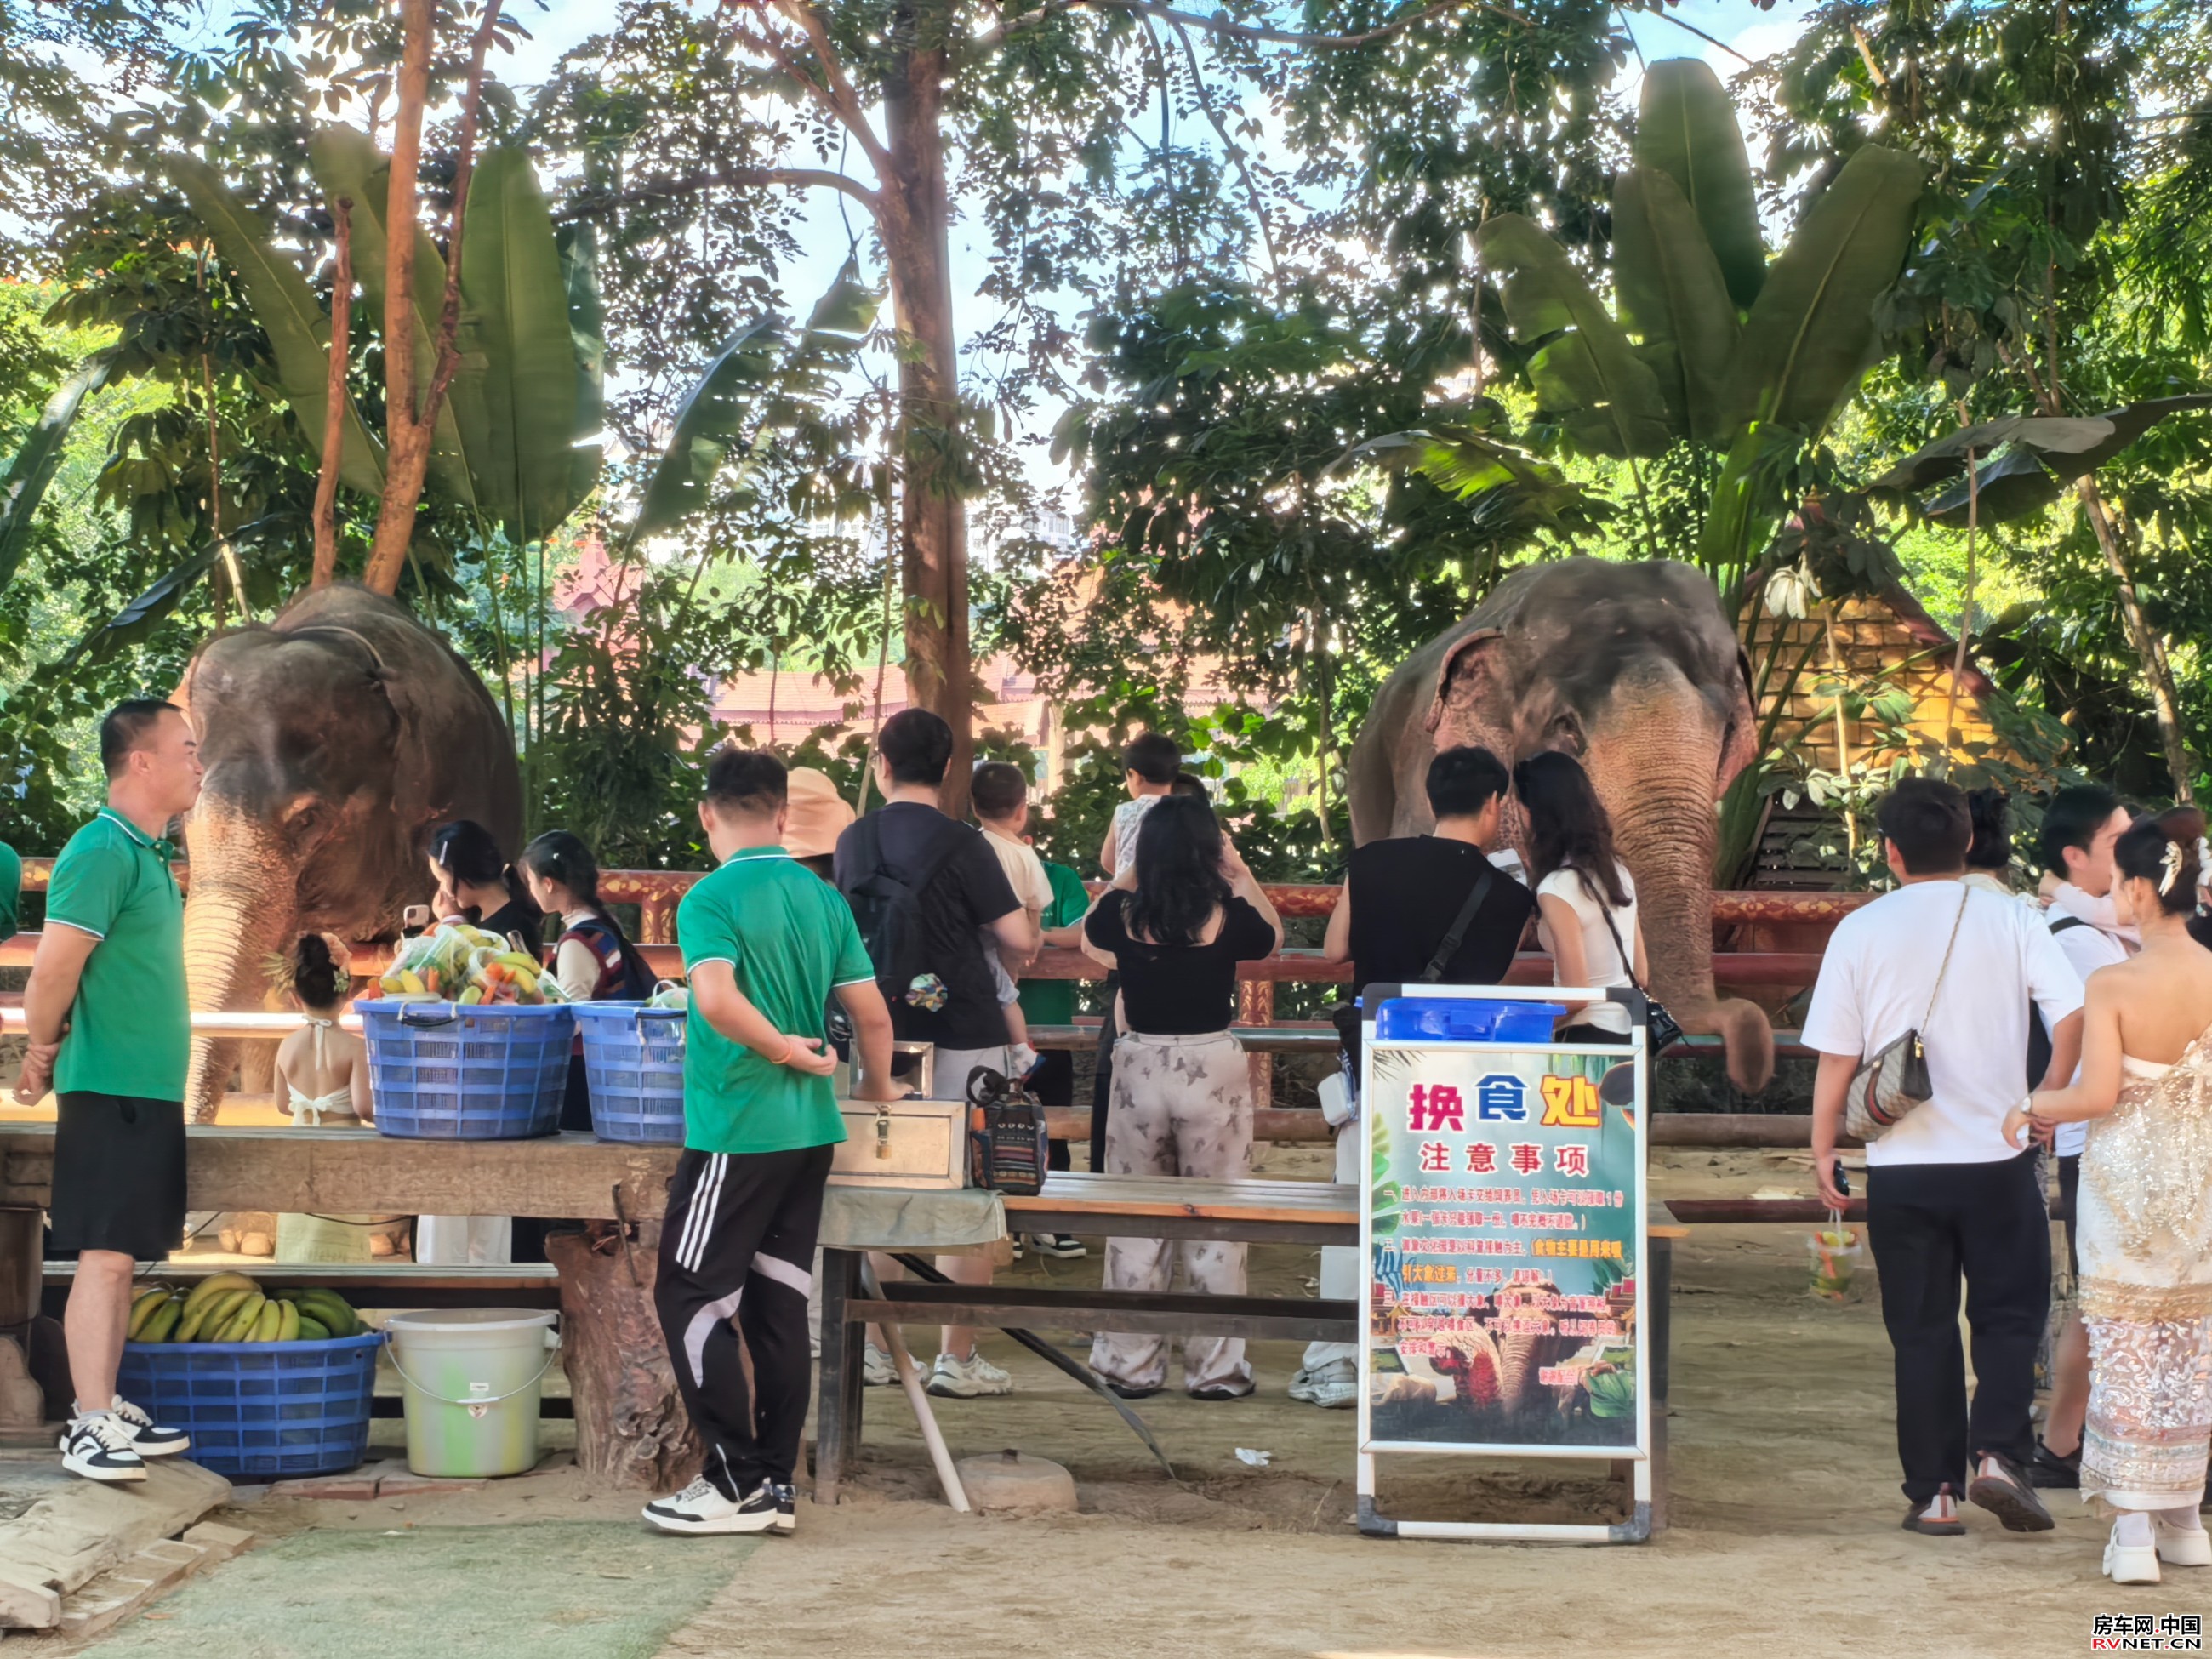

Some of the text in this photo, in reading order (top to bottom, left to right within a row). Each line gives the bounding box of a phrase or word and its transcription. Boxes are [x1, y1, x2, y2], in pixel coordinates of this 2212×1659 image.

[1408, 1074, 1600, 1132] 换食处
[1420, 1142, 1589, 1176] 注意事项
